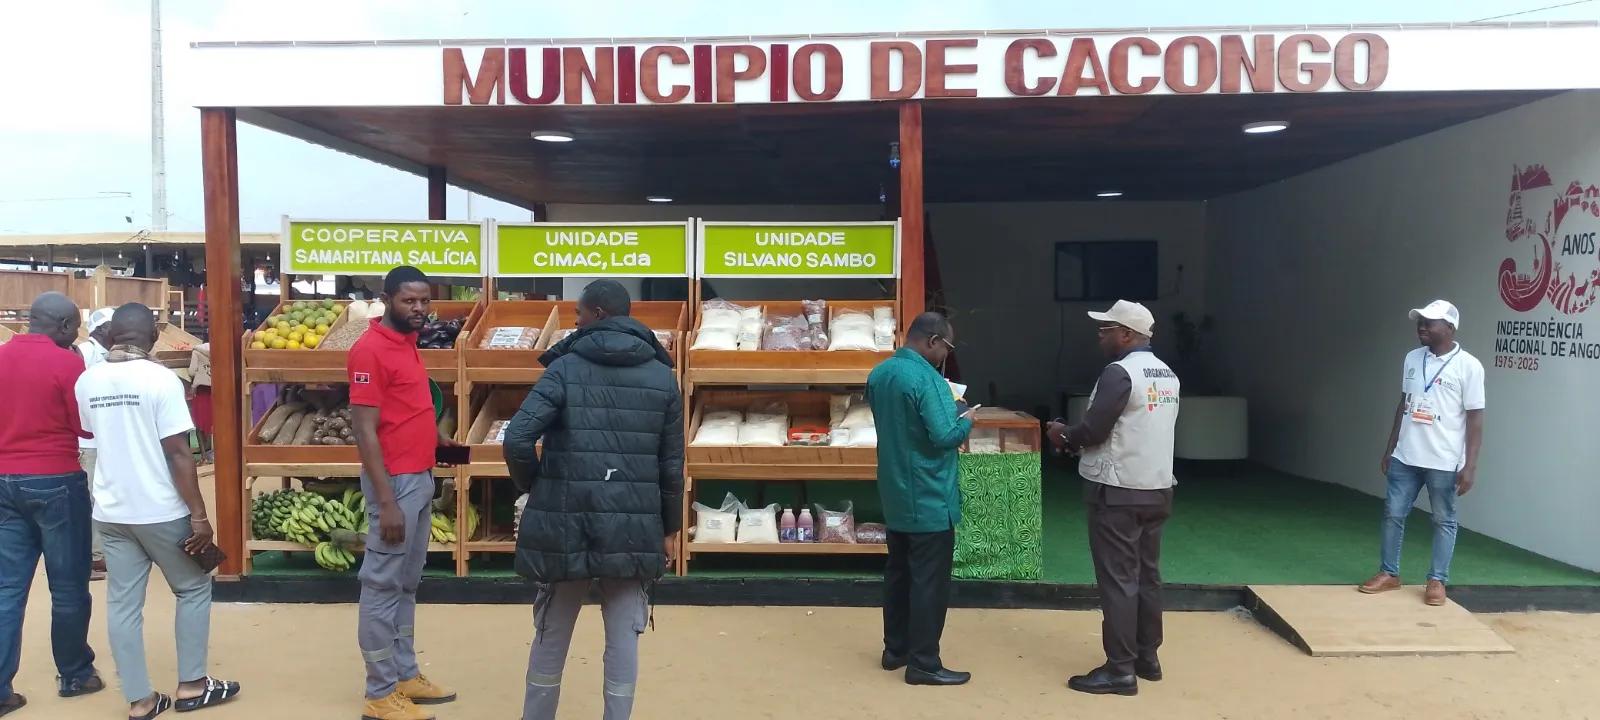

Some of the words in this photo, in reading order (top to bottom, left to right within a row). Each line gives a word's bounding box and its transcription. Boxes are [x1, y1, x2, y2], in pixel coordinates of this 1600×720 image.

[443, 44, 843, 104] MUNICIPIO
[870, 40, 977, 100] DE
[1006, 34, 1389, 96] CACONGO
[302, 228, 470, 244] COOPERATIVA
[545, 231, 639, 246] UNIDADE
[755, 231, 846, 246] UNIDADE
[1561, 232, 1596, 256] ANOS
[295, 249, 404, 266] SAMARITANA
[408, 247, 477, 266] SALÍCIA
[533, 251, 608, 270] CIMAC,
[611, 251, 651, 267] Lda
[724, 251, 802, 268] SILVANO
[806, 251, 877, 268] SAMBO
[1496, 317, 1583, 339] INDEPENDÊNCIA
[1495, 338, 1546, 356] NACIONAL
[1551, 341, 1566, 357] DE
